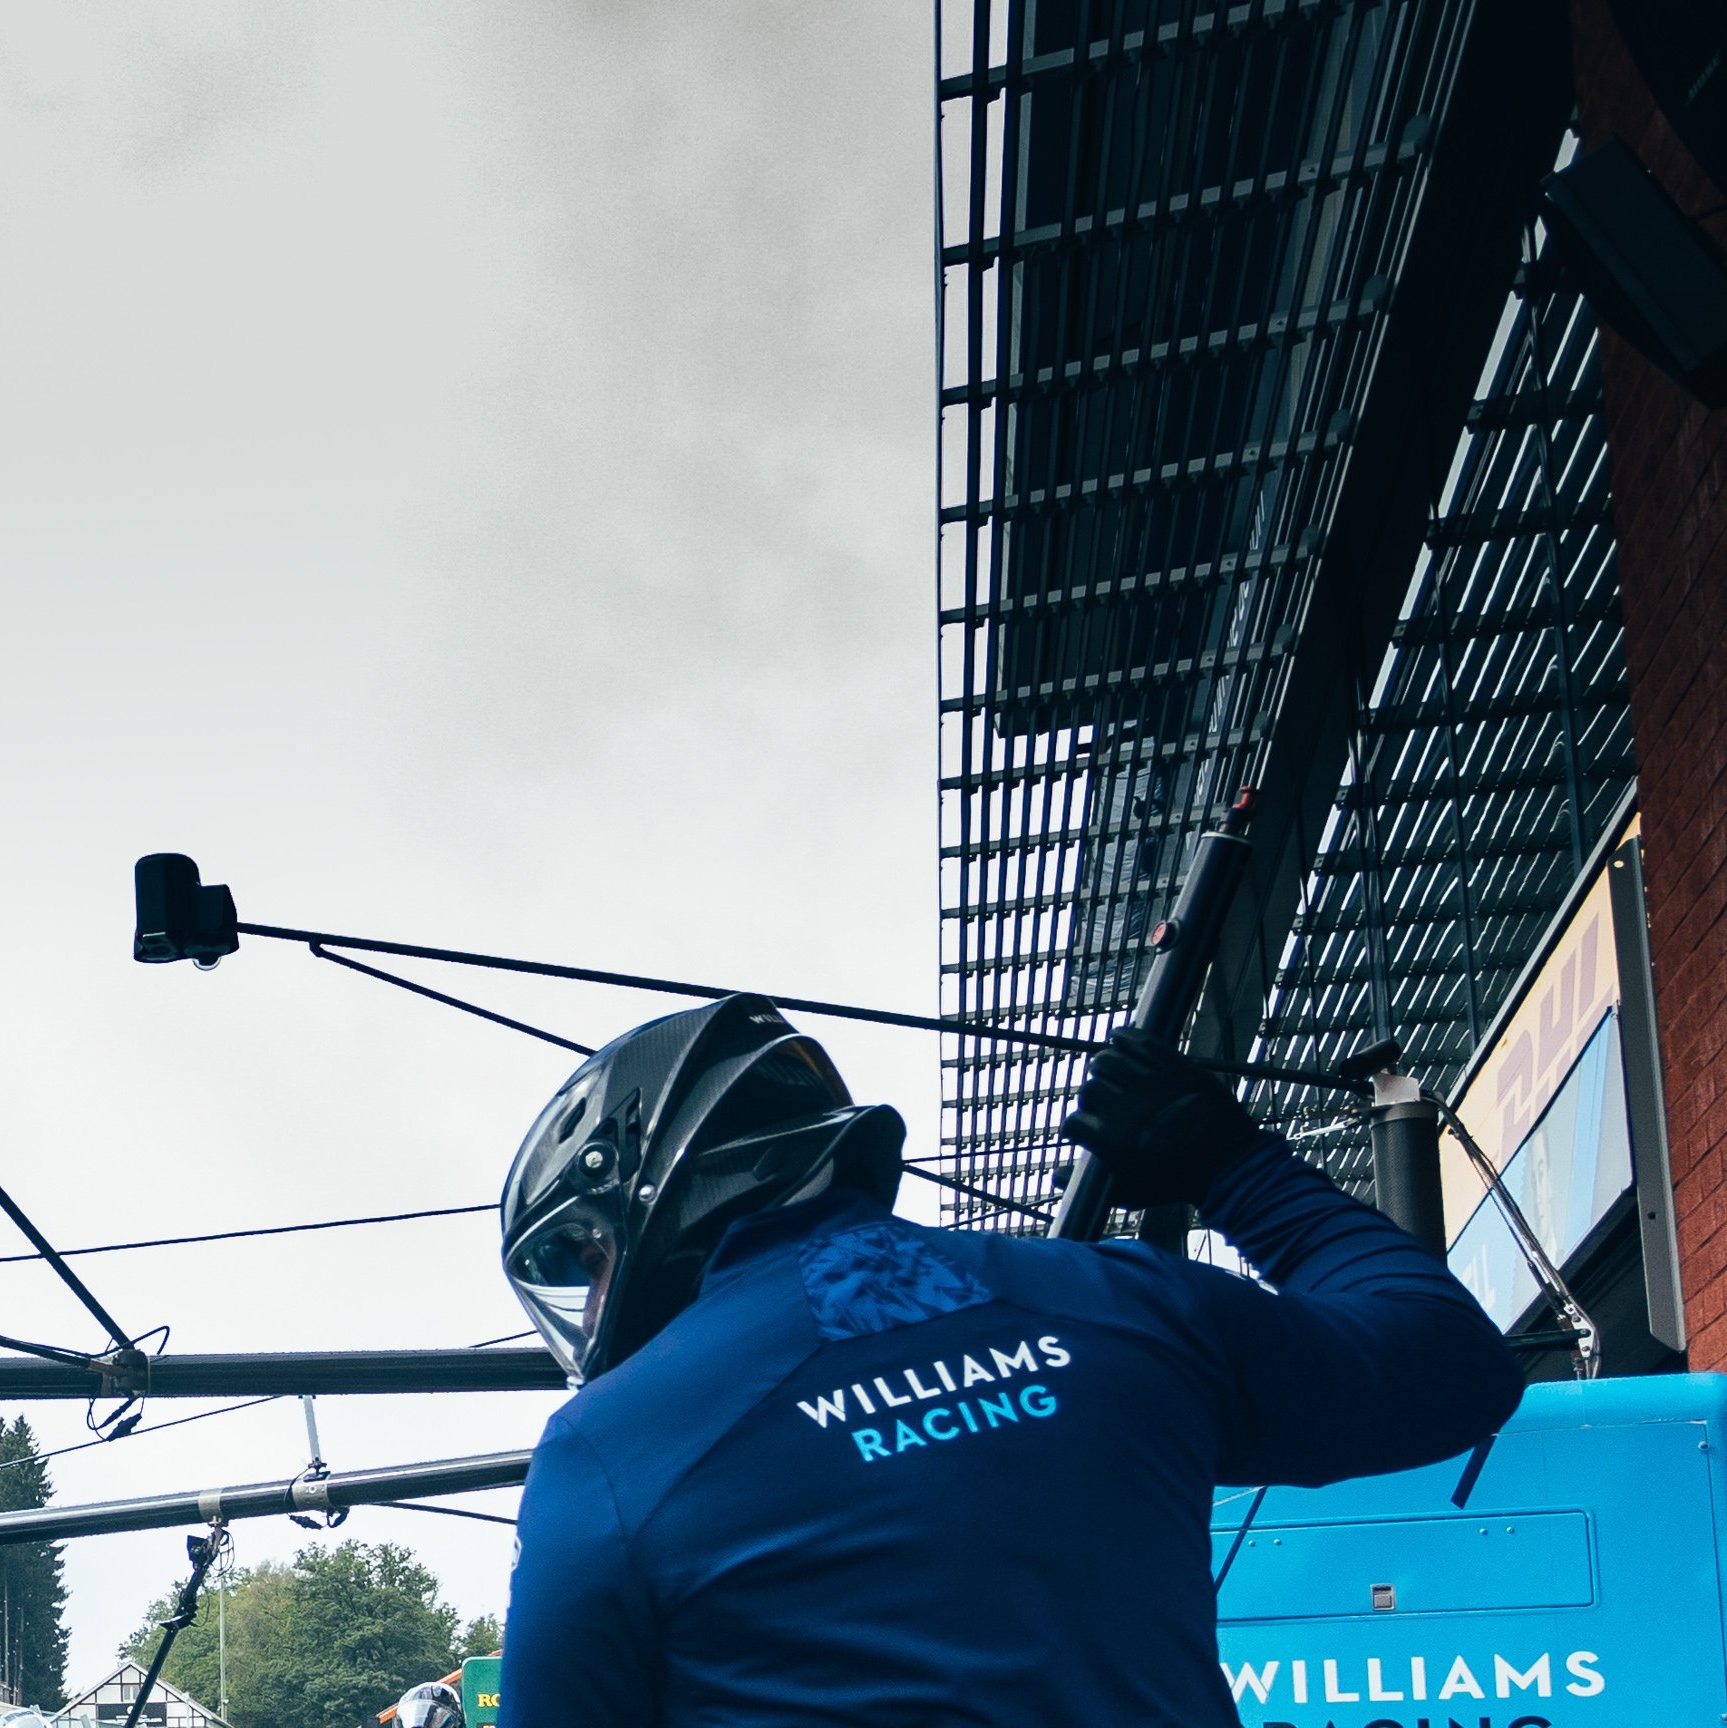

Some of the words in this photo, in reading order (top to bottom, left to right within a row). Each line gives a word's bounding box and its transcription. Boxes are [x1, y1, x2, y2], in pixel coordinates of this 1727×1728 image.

[797, 1336, 1071, 1428] WILLIAMS
[851, 1385, 1057, 1462] RACING
[1220, 1651, 1605, 1704] WILLIAMS
